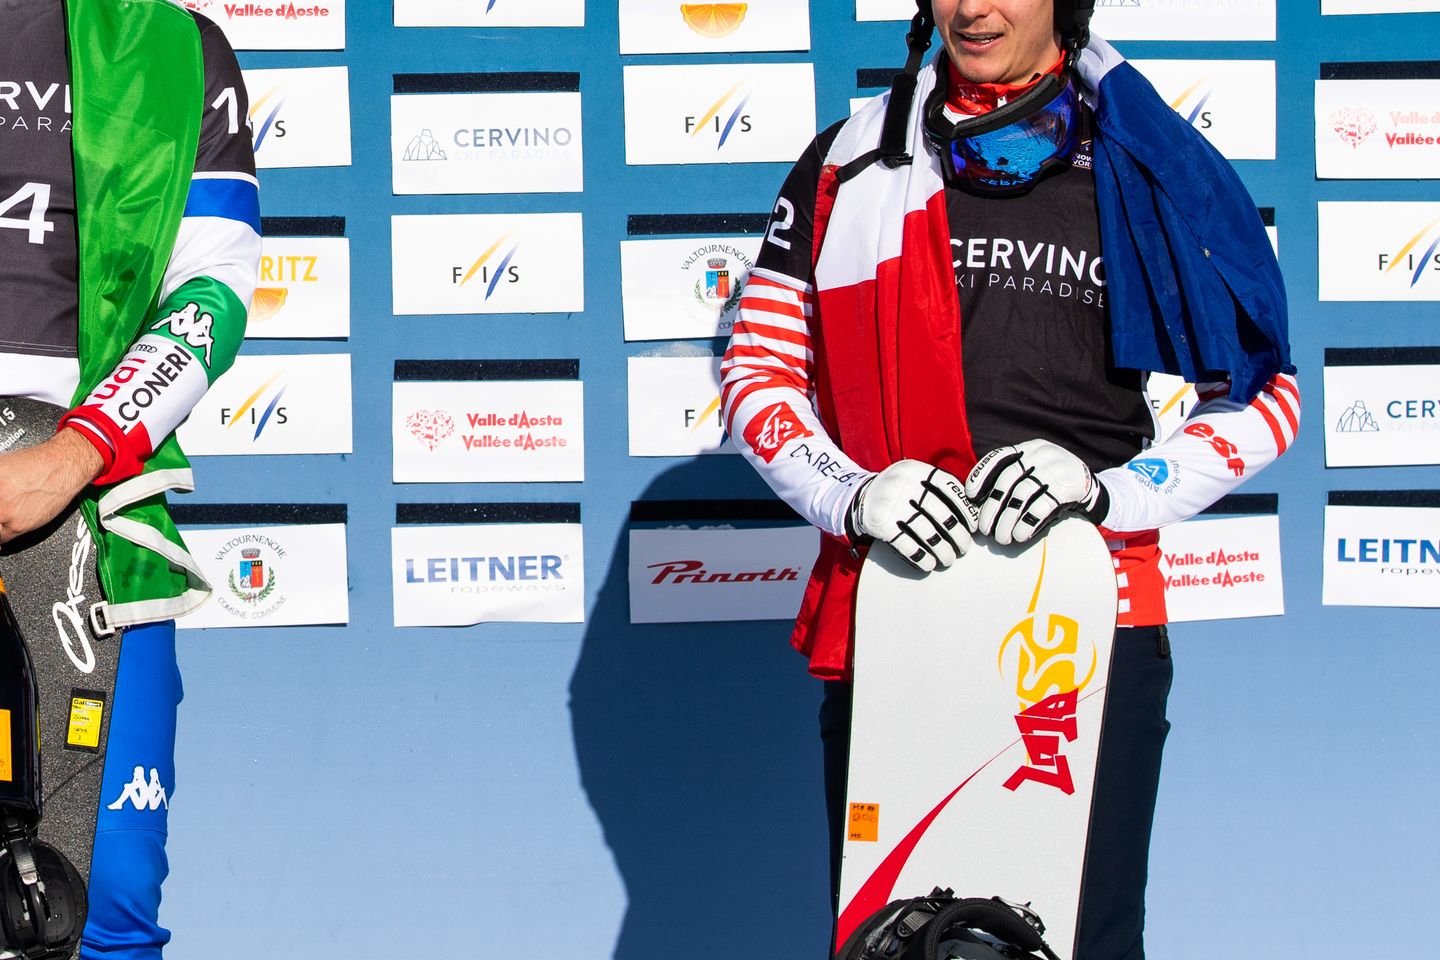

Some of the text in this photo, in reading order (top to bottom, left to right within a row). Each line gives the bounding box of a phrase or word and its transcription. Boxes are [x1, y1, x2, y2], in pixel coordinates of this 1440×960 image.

[224, 4, 274, 20] Vallée
[685, 115, 752, 133] FIS
[454, 127, 571, 149] CERVINO
[1385, 133, 1434, 149] Vallée
[260, 256, 318, 282] RITZ
[452, 266, 520, 284] FIS
[955, 273, 1104, 308] KI PARADISE
[120, 345, 192, 431] CONERI
[221, 407, 288, 425] FIS
[467, 413, 507, 428] Valle
[462, 435, 511, 451] Vallée
[968, 447, 1004, 483] reusch
[946, 480, 979, 522] reusch
[215, 534, 288, 561] VALTOURNENCHE
[406, 555, 564, 584] LEITNER
[1165, 553, 1204, 569] Valle
[647, 560, 801, 585] Prinoth
[1164, 573, 1210, 591] Vallée
